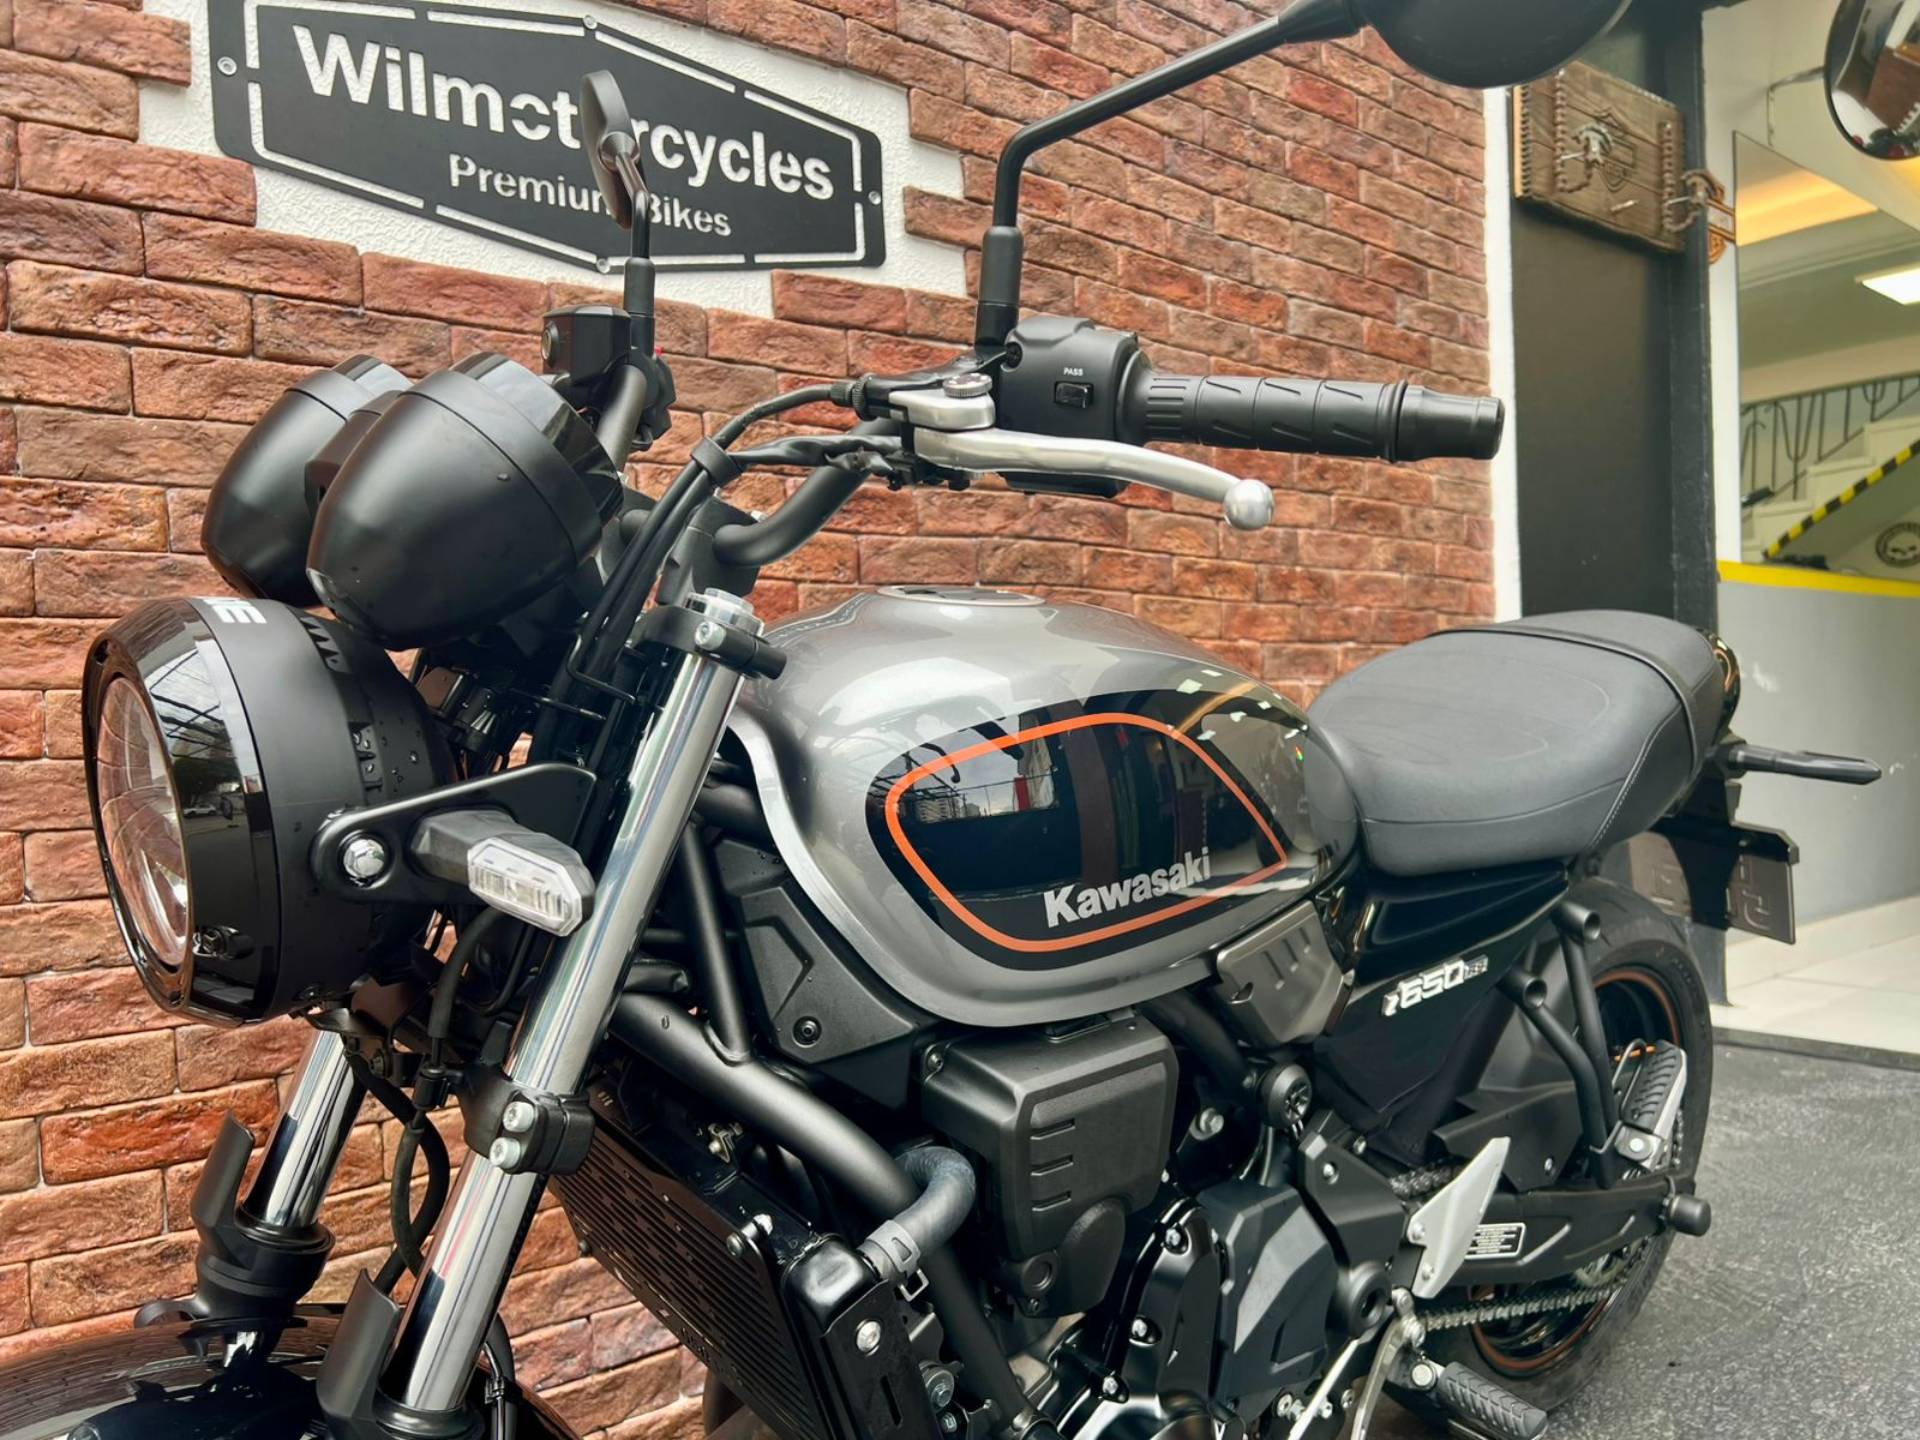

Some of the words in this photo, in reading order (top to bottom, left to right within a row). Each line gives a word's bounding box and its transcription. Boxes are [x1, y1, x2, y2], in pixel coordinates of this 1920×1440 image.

[292, 24, 836, 200] Wilmotrcycles
[1063, 366, 1084, 377] PASS
[1043, 847, 1212, 929] Kawasaki
